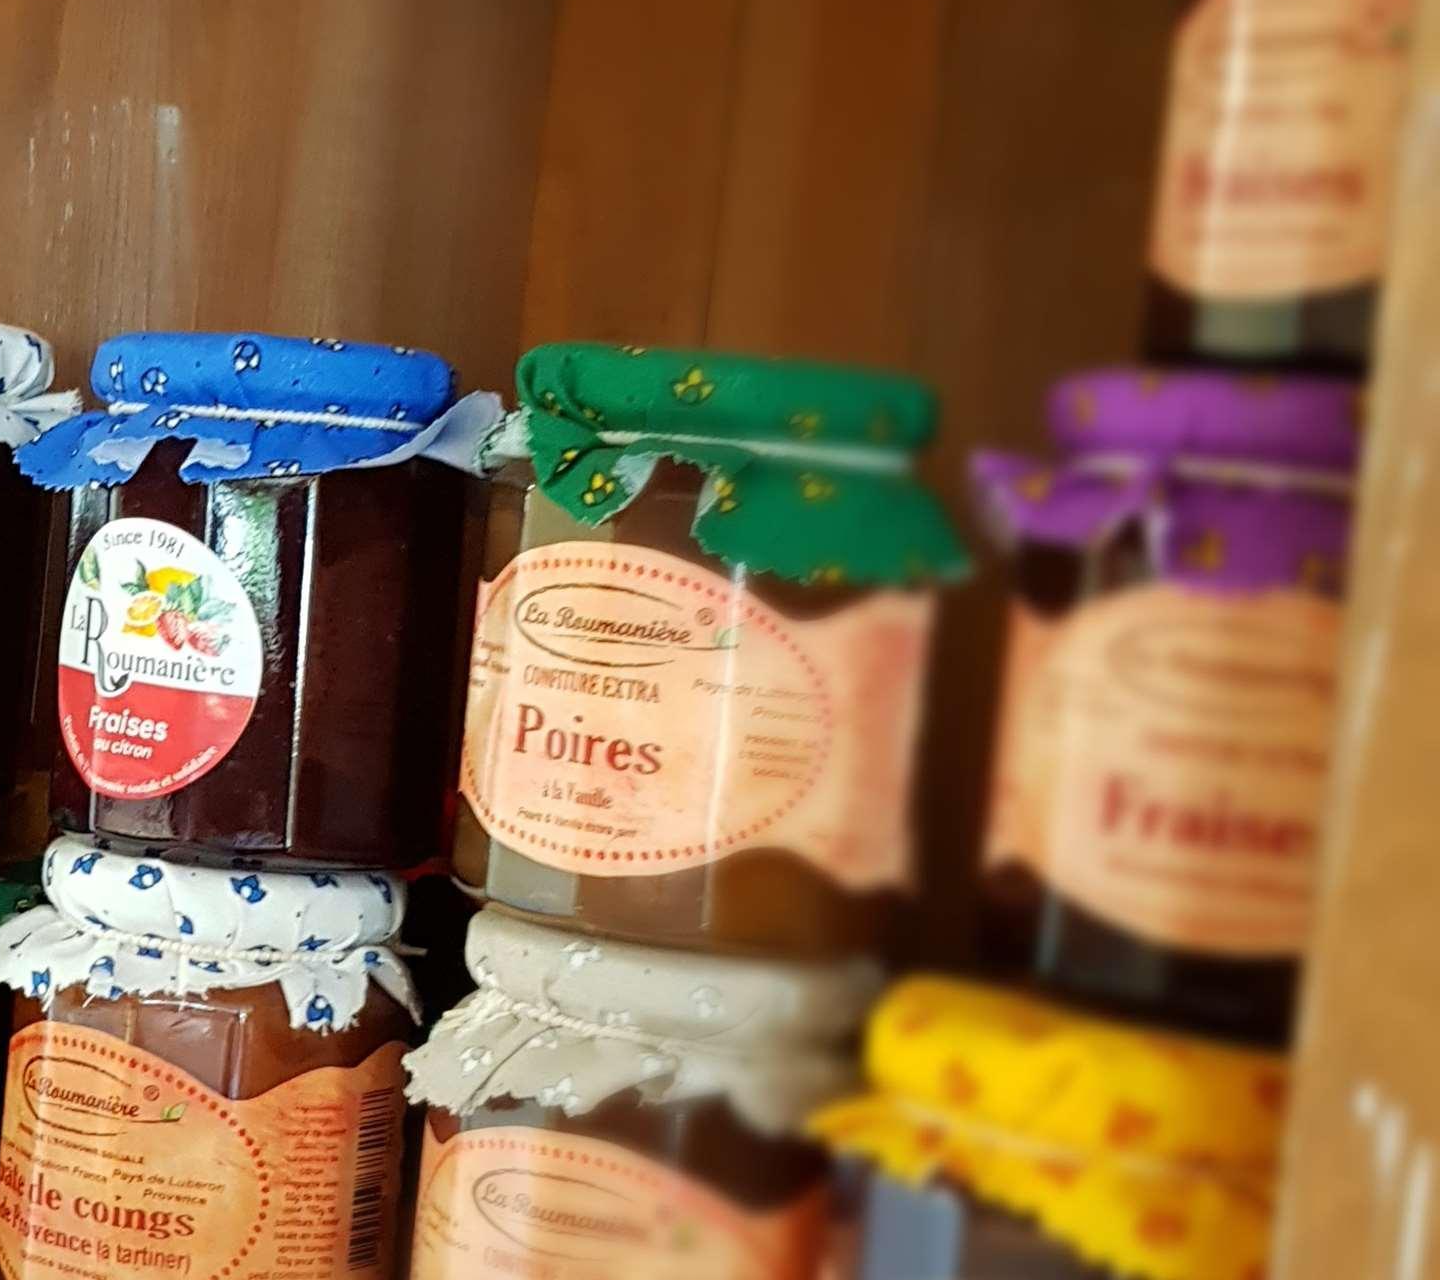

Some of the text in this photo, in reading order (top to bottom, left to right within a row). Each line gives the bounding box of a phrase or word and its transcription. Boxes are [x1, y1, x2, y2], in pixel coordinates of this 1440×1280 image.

[103, 528, 186, 558] Since 1981
[523, 602, 693, 645] La Roumanière
[82, 596, 236, 694] Roumanière
[600, 675, 662, 704] EXTRA
[88, 705, 169, 742] Fraises
[513, 702, 663, 776] Poires
[94, 736, 110, 751] au
[110, 738, 153, 759] citron
[38, 1076, 141, 1118] Roumanière
[27, 1171, 63, 1211] de
[73, 1195, 196, 1241] coings
[116, 1244, 192, 1276] tartiner)
